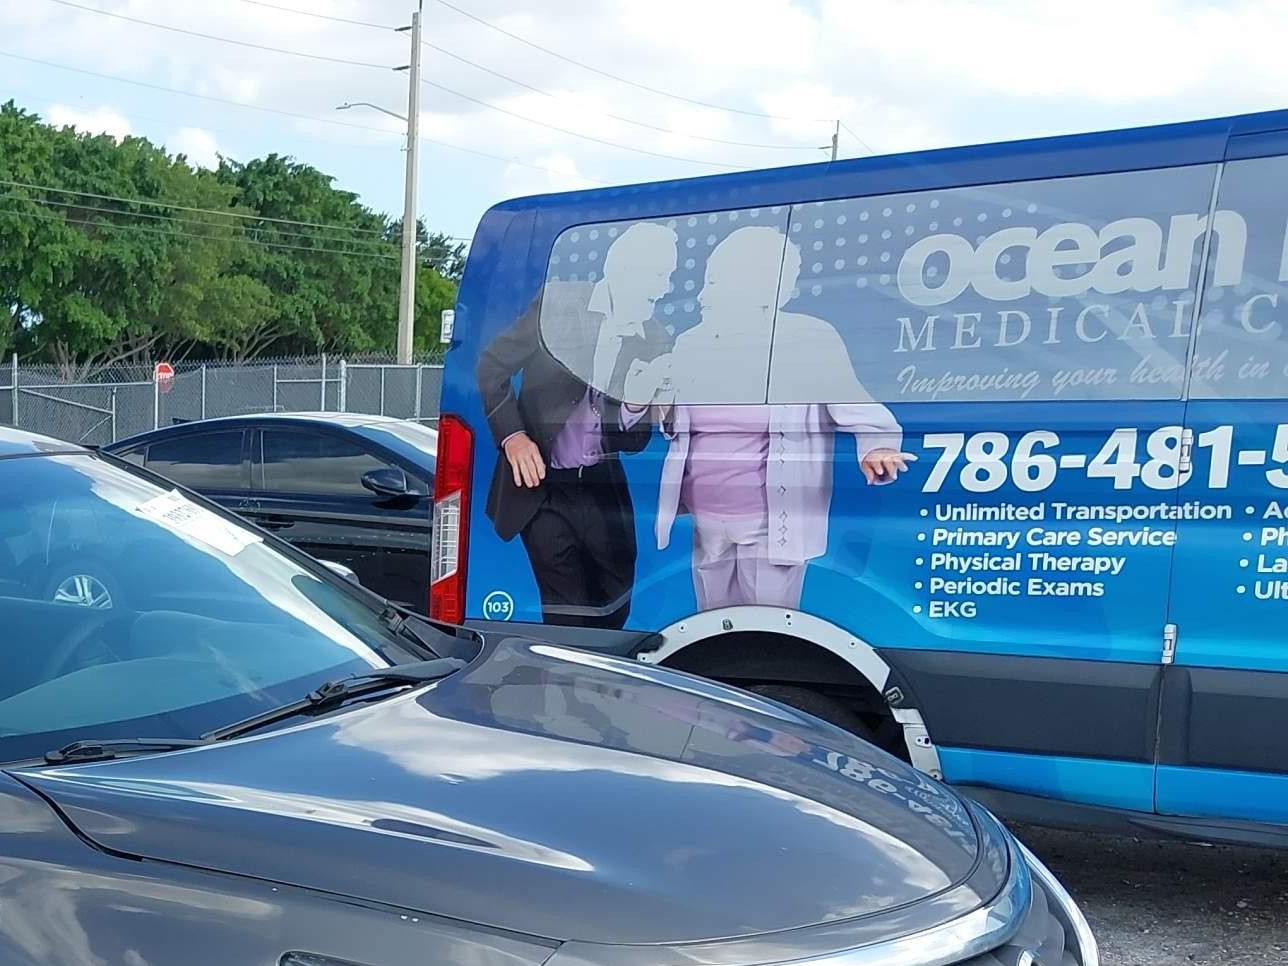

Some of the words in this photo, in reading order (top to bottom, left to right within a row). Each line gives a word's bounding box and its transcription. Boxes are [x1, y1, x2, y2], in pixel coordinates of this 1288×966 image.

[897, 210, 1247, 306] ocean
[893, 300, 1198, 353] MEDICAL
[897, 365, 1040, 400] Improving
[1051, 368, 1117, 397] your
[1238, 355, 1270, 379] in
[935, 503, 1044, 521] Unlimited
[1052, 502, 1232, 524] Transportation
[933, 528, 1020, 549] Primary
[1026, 529, 1080, 545] Care
[1087, 526, 1177, 546] Service
[931, 553, 1021, 574] Physical
[1028, 553, 1126, 575] Therapy
[929, 577, 1020, 596] Periodic
[1028, 579, 1104, 596] Exams
[487, 601, 509, 613] 103
[929, 600, 977, 618] EKG
